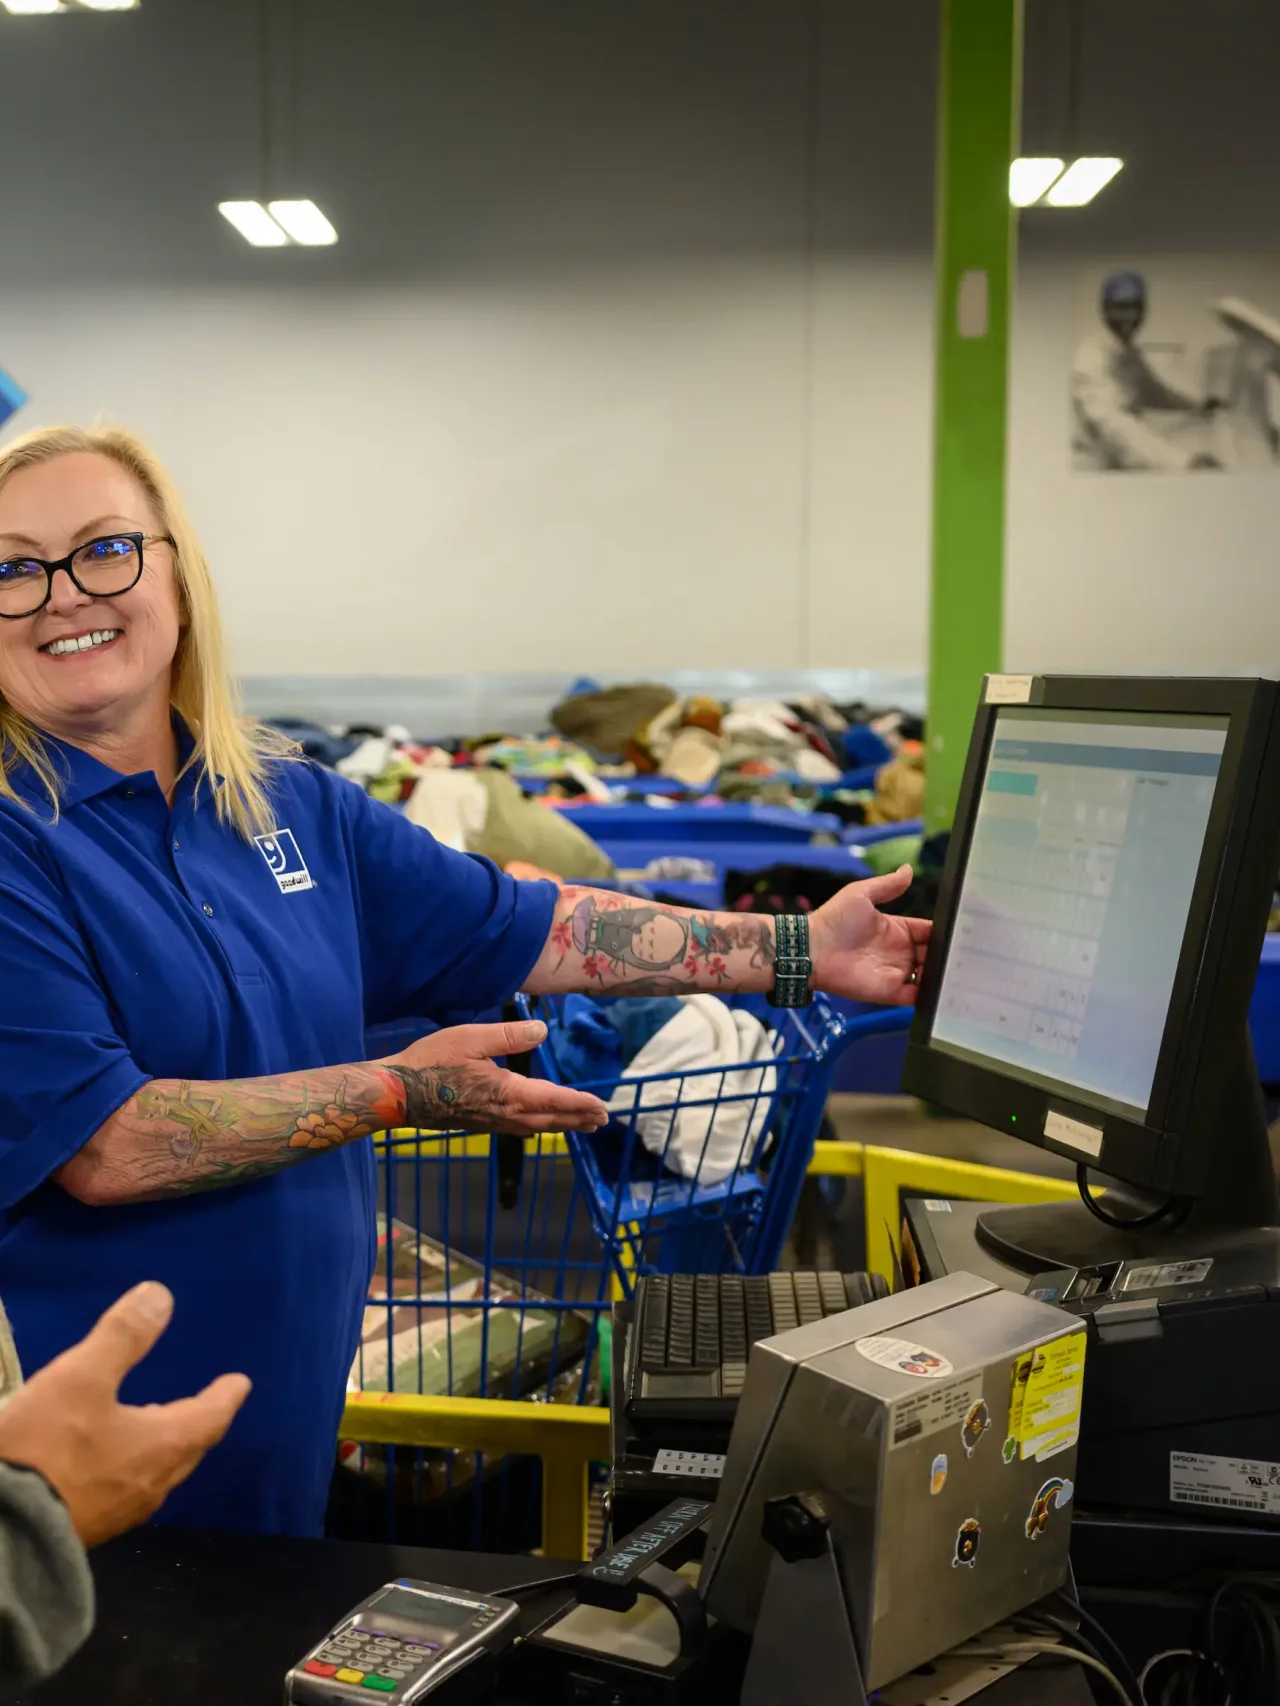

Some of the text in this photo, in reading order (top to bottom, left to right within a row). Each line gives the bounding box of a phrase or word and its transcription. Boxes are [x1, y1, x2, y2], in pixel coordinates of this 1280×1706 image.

[280, 873, 309, 890] goodwill
[1172, 1454, 1197, 1463] EPSON
[624, 1531, 667, 1553] AFTER
